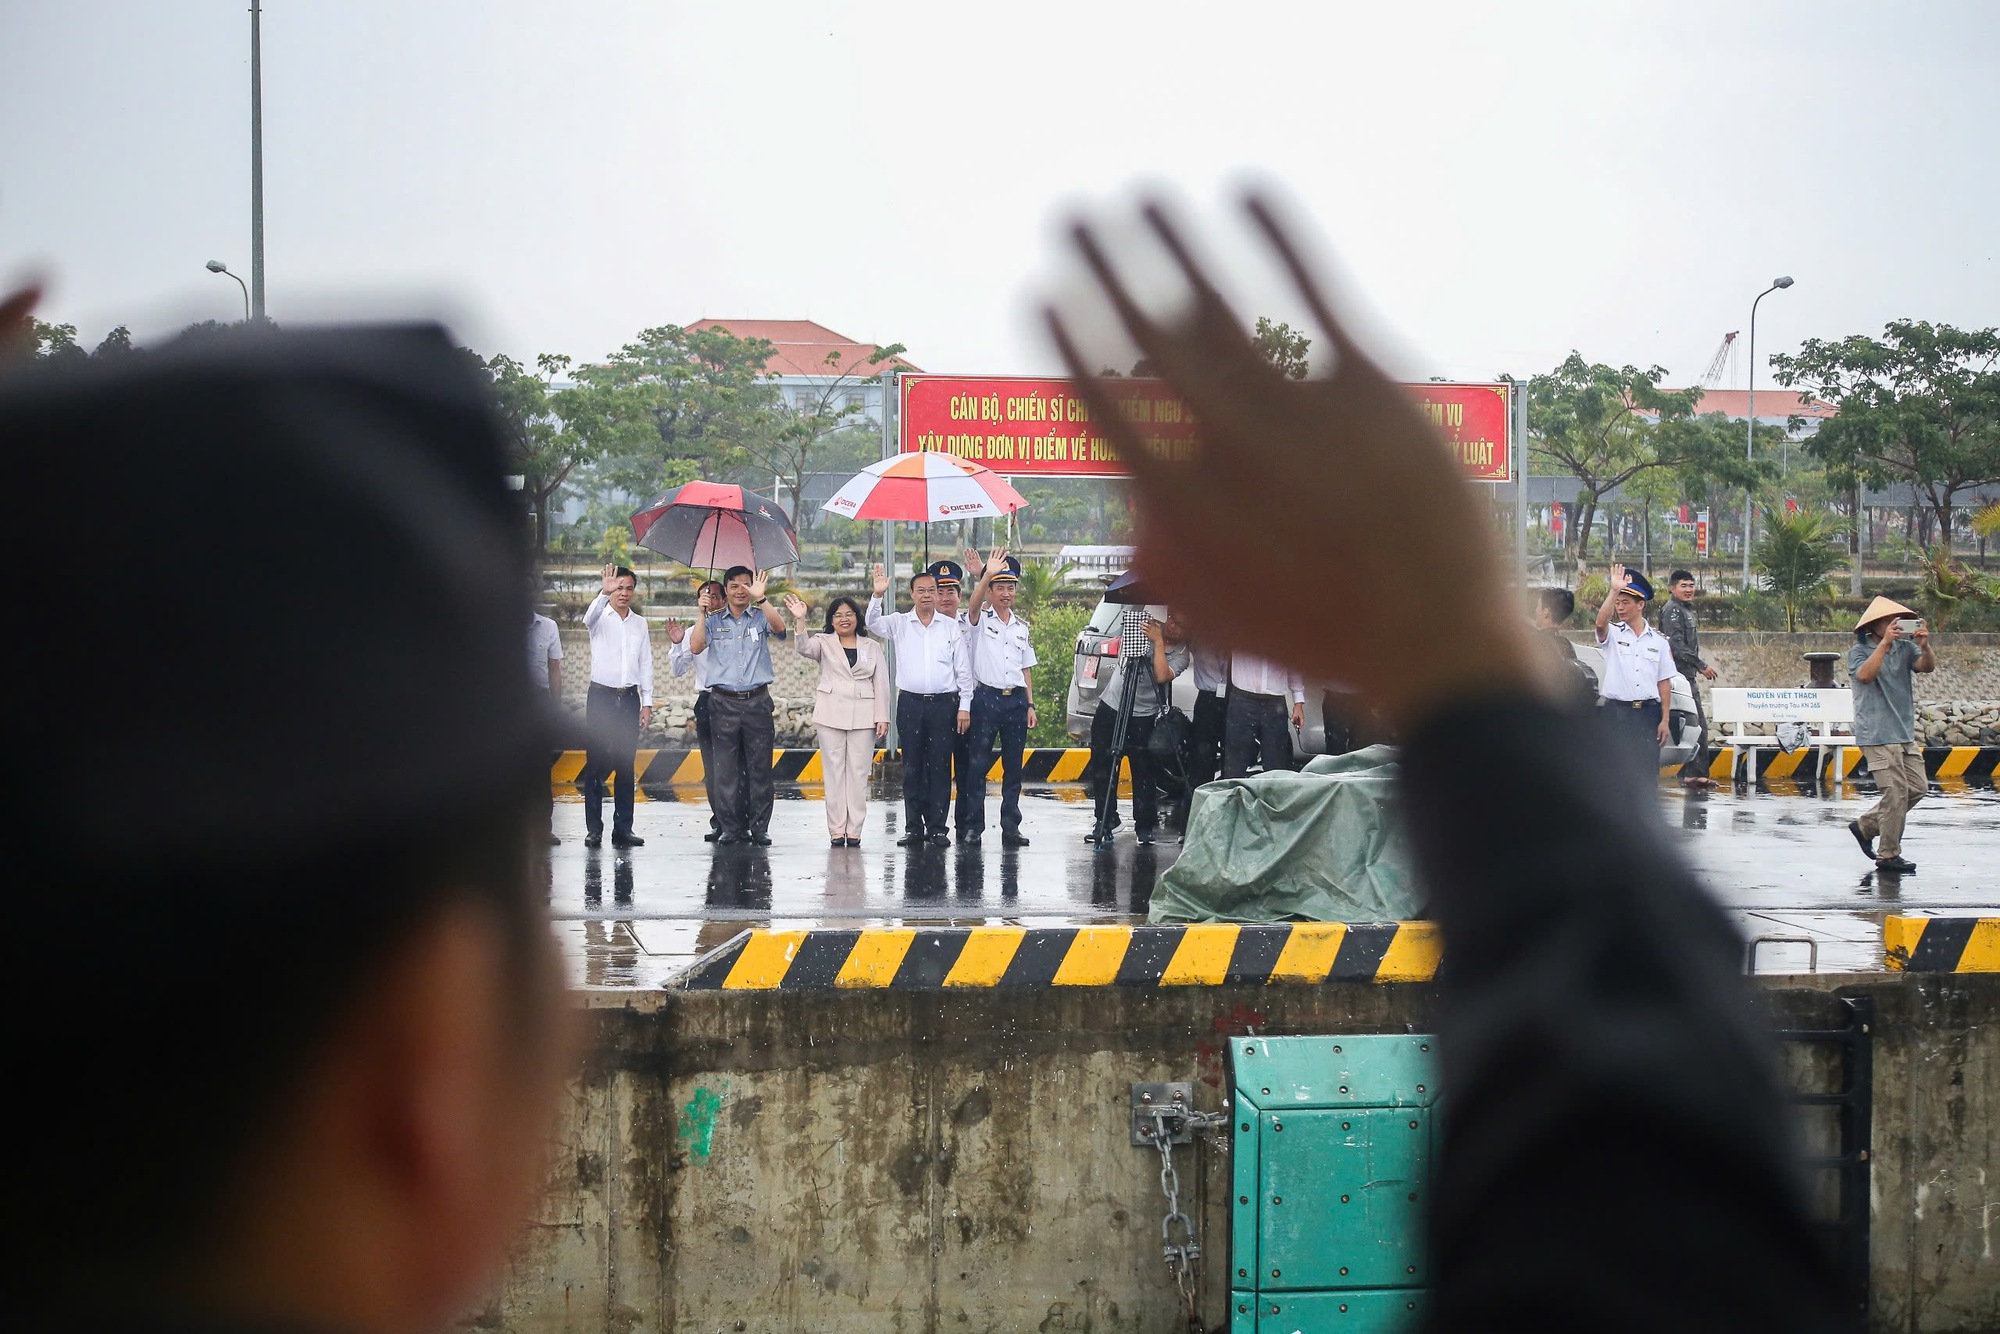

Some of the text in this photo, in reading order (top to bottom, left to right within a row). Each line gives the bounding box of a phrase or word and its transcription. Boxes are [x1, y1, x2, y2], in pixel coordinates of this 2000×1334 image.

[950, 391, 978, 420] CÁN
[981, 392, 1003, 426] BỘ,
[1006, 390, 1046, 421] CHIẾN
[1050, 393, 1064, 422] SĨ
[1446, 403, 1463, 431] VỤ
[917, 429, 944, 453] XÂY
[987, 433, 1014, 460] ĐƠN
[1018, 436, 1031, 465] VỊ
[1034, 427, 1068, 461] ĐIỂM
[1071, 430, 1087, 461] VỀ
[1090, 437, 1120, 461] HU
[1463, 437, 1494, 470] LUẬT
[950, 503, 984, 511] DICERA
